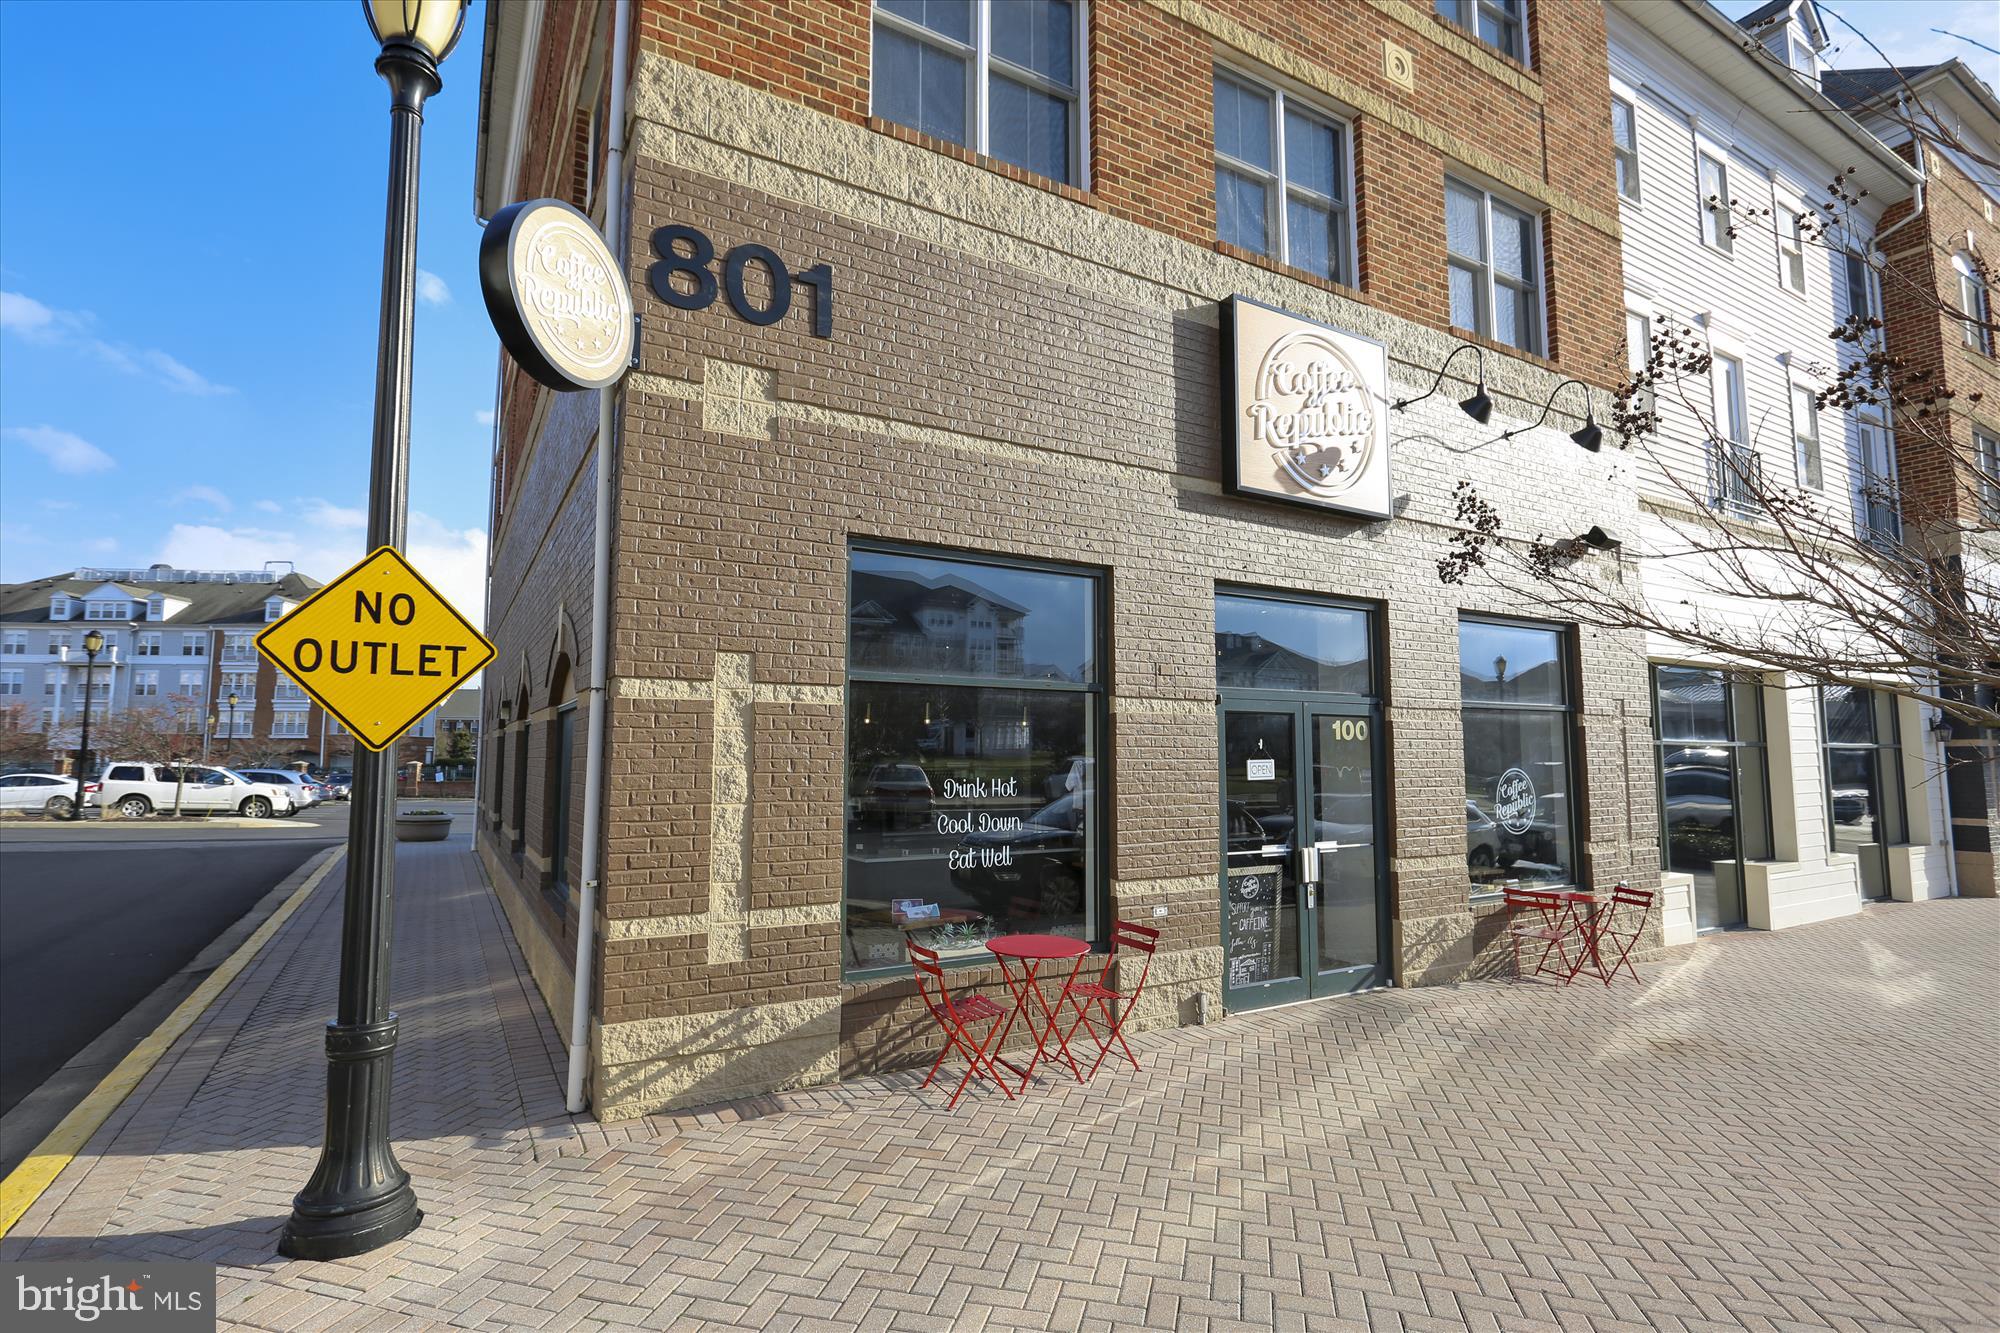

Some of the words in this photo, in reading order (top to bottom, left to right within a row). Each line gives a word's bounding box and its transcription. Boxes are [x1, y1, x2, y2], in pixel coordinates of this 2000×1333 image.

[536, 239, 606, 292] Coffee
[649, 224, 832, 339] 801
[518, 272, 620, 329] Republic
[1268, 360, 1358, 409] Coffee
[1246, 400, 1374, 454] Republic
[354, 590, 416, 626] NO
[293, 637, 467, 678] OUTLET
[1332, 720, 1368, 741] 100
[1251, 764, 1272, 776] OPEN
[943, 777, 987, 799] Drink
[991, 776, 1018, 798] Hot
[1500, 779, 1528, 801] Coffee
[1494, 793, 1534, 820] Republic
[937, 812, 974, 835] Cool
[978, 812, 1023, 833] Down
[948, 849, 977, 870] Eat
[981, 845, 1013, 867] Well
